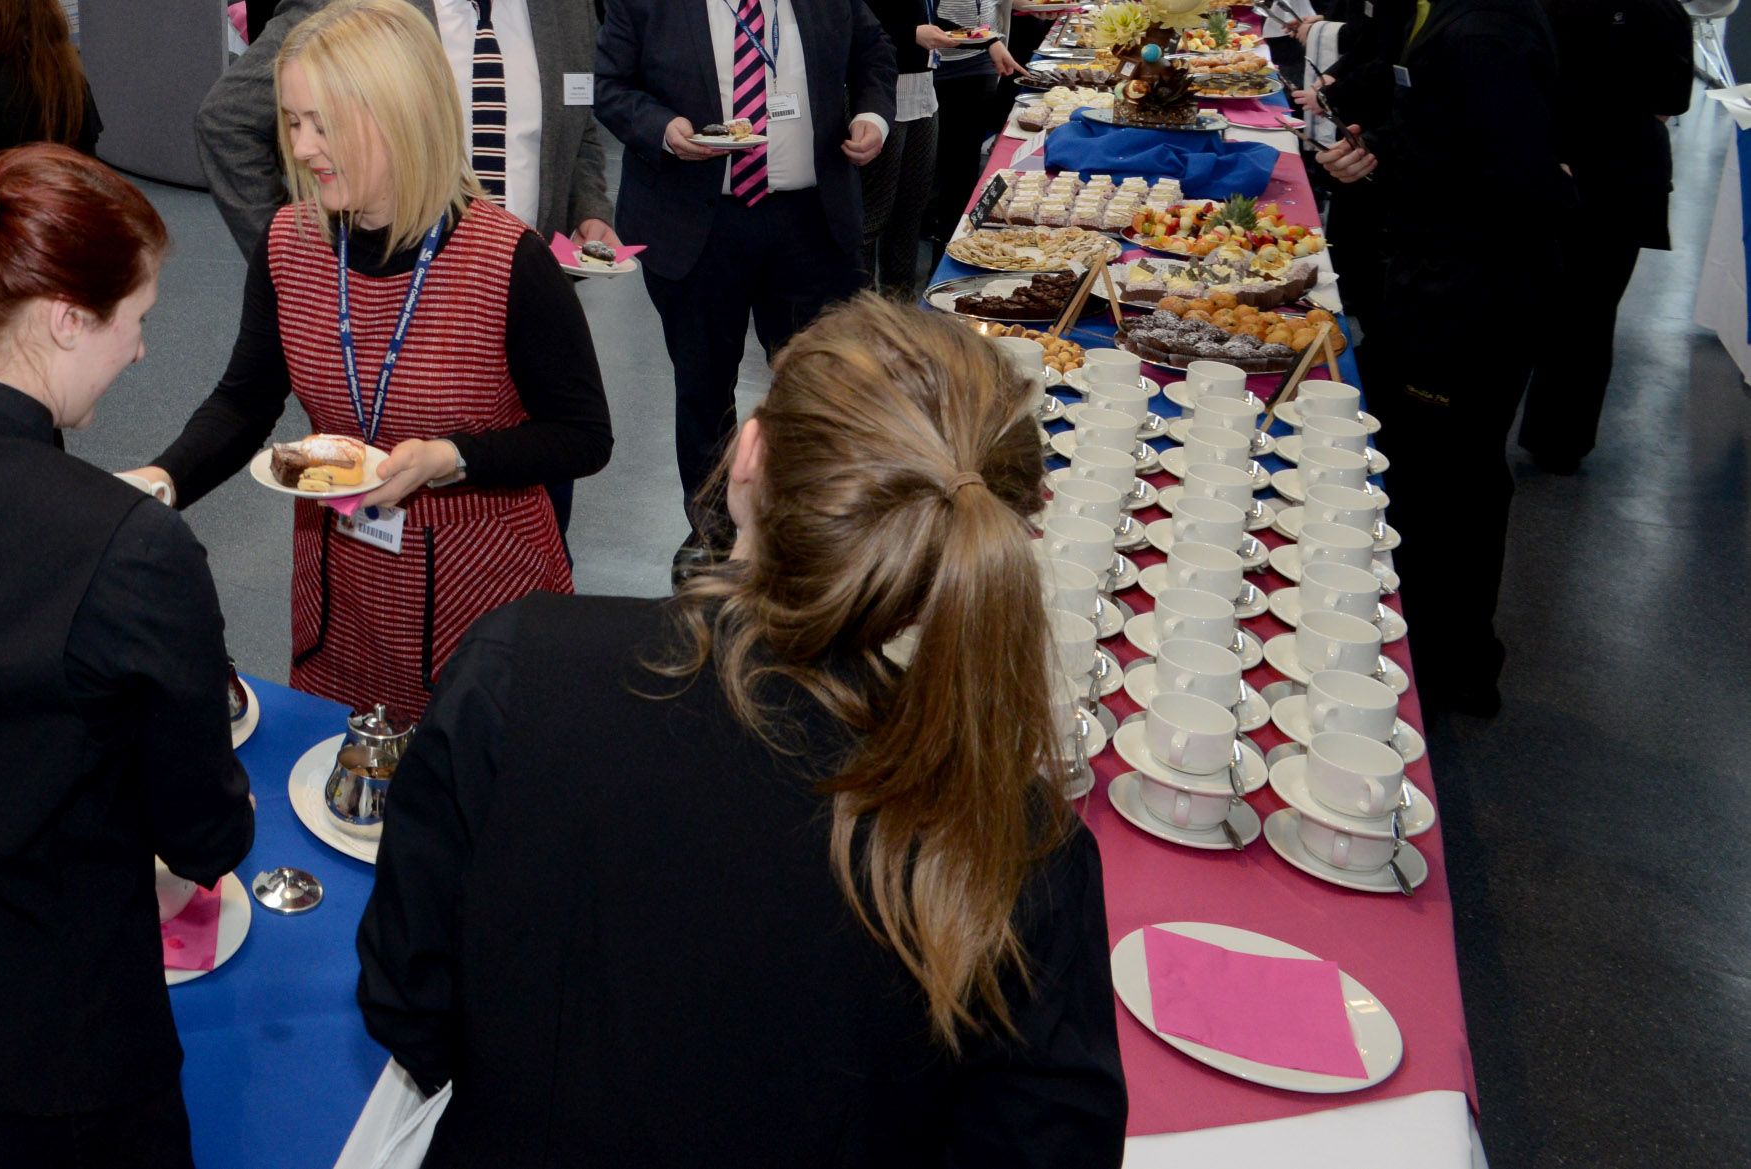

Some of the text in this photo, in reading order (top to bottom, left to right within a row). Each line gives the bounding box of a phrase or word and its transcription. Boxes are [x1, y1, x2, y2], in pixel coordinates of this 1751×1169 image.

[395, 267, 425, 341] Gower College Swansea
[379, 370, 389, 391] Gower
[374, 390, 384, 414] College
